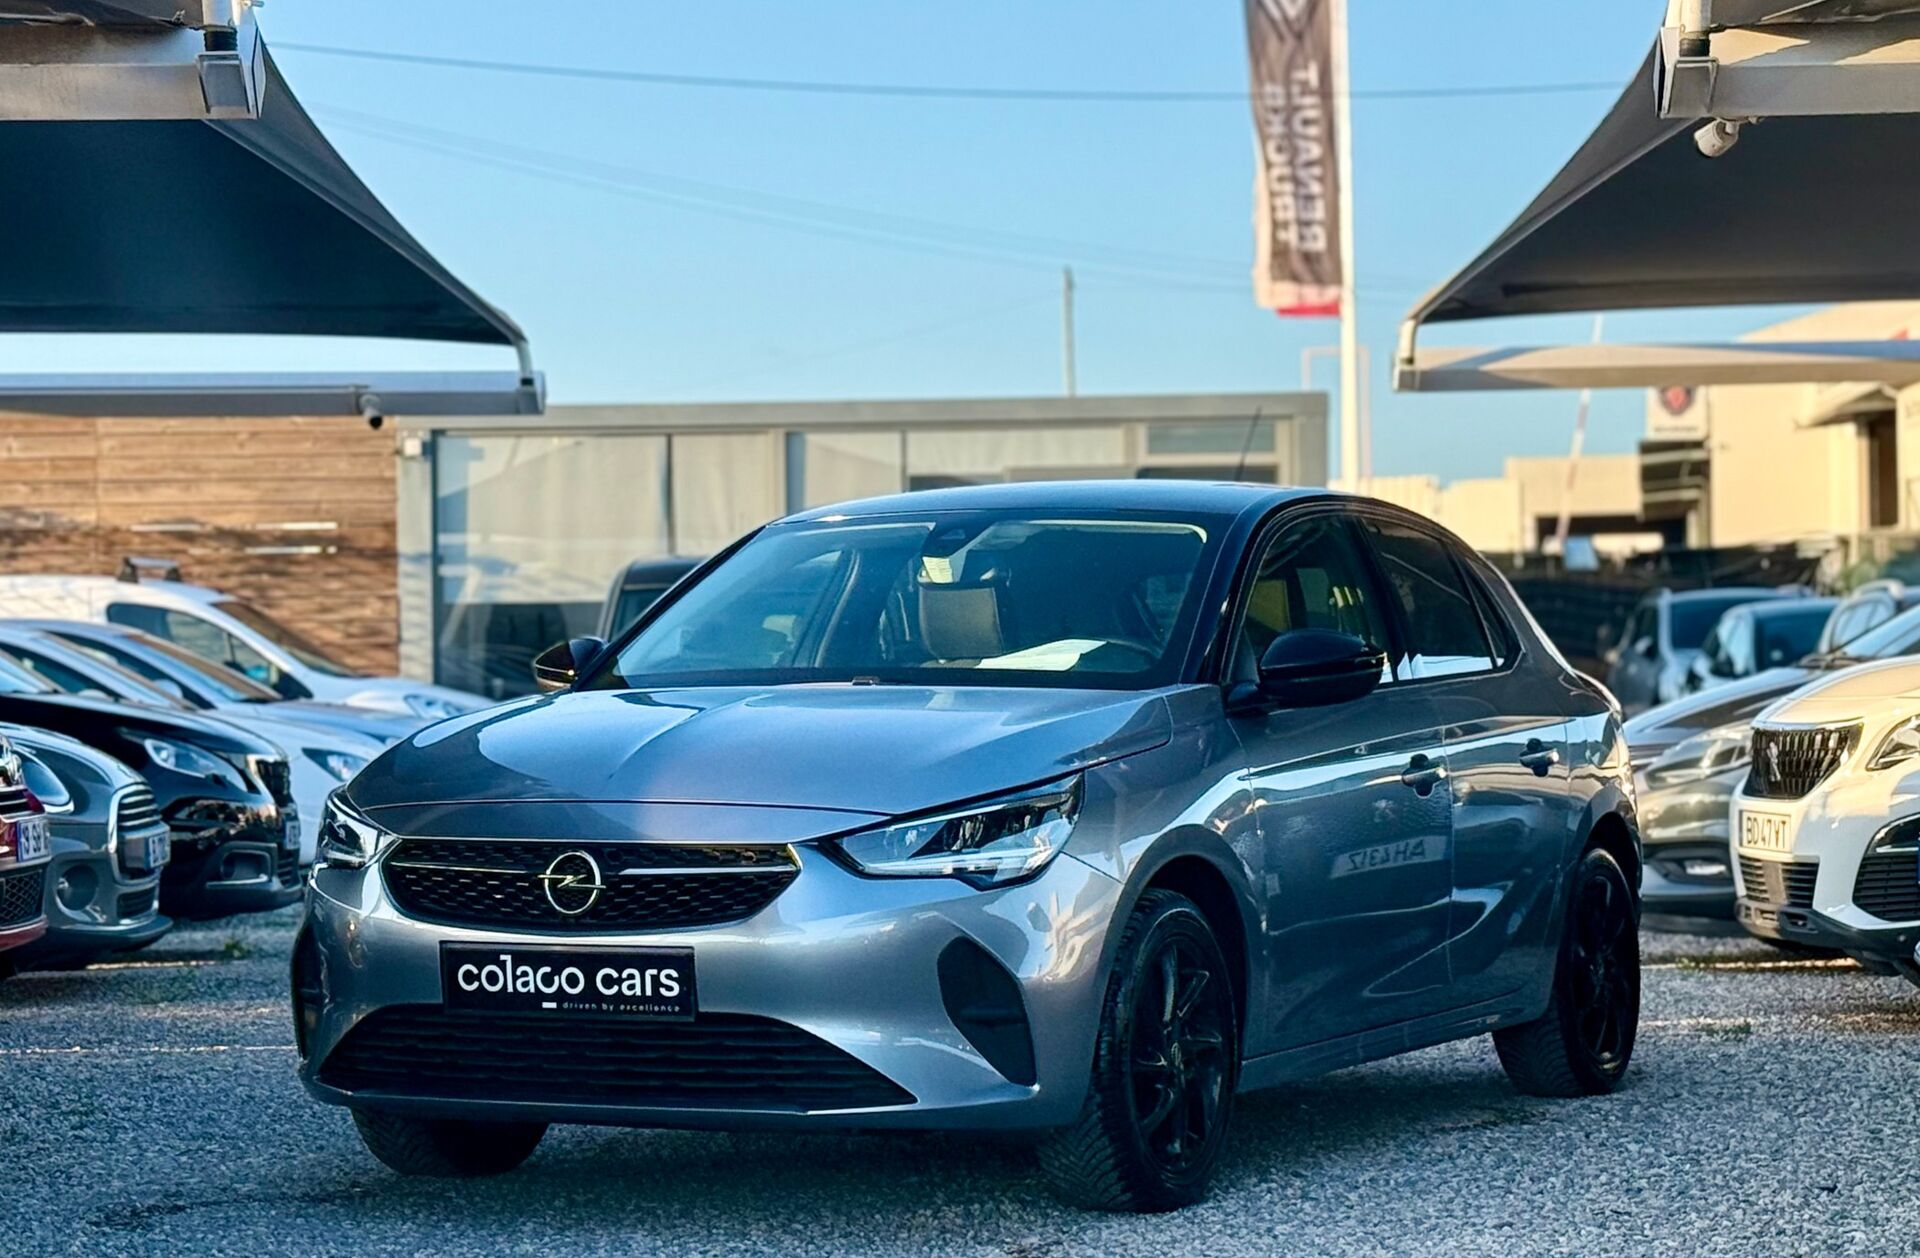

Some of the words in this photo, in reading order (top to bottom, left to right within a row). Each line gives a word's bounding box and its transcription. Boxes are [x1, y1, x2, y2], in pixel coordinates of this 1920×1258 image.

[595, 967, 680, 997] cars
[562, 1001, 597, 1010] driven
[601, 1002, 615, 1012] by
[619, 1004, 680, 1013] excellence
